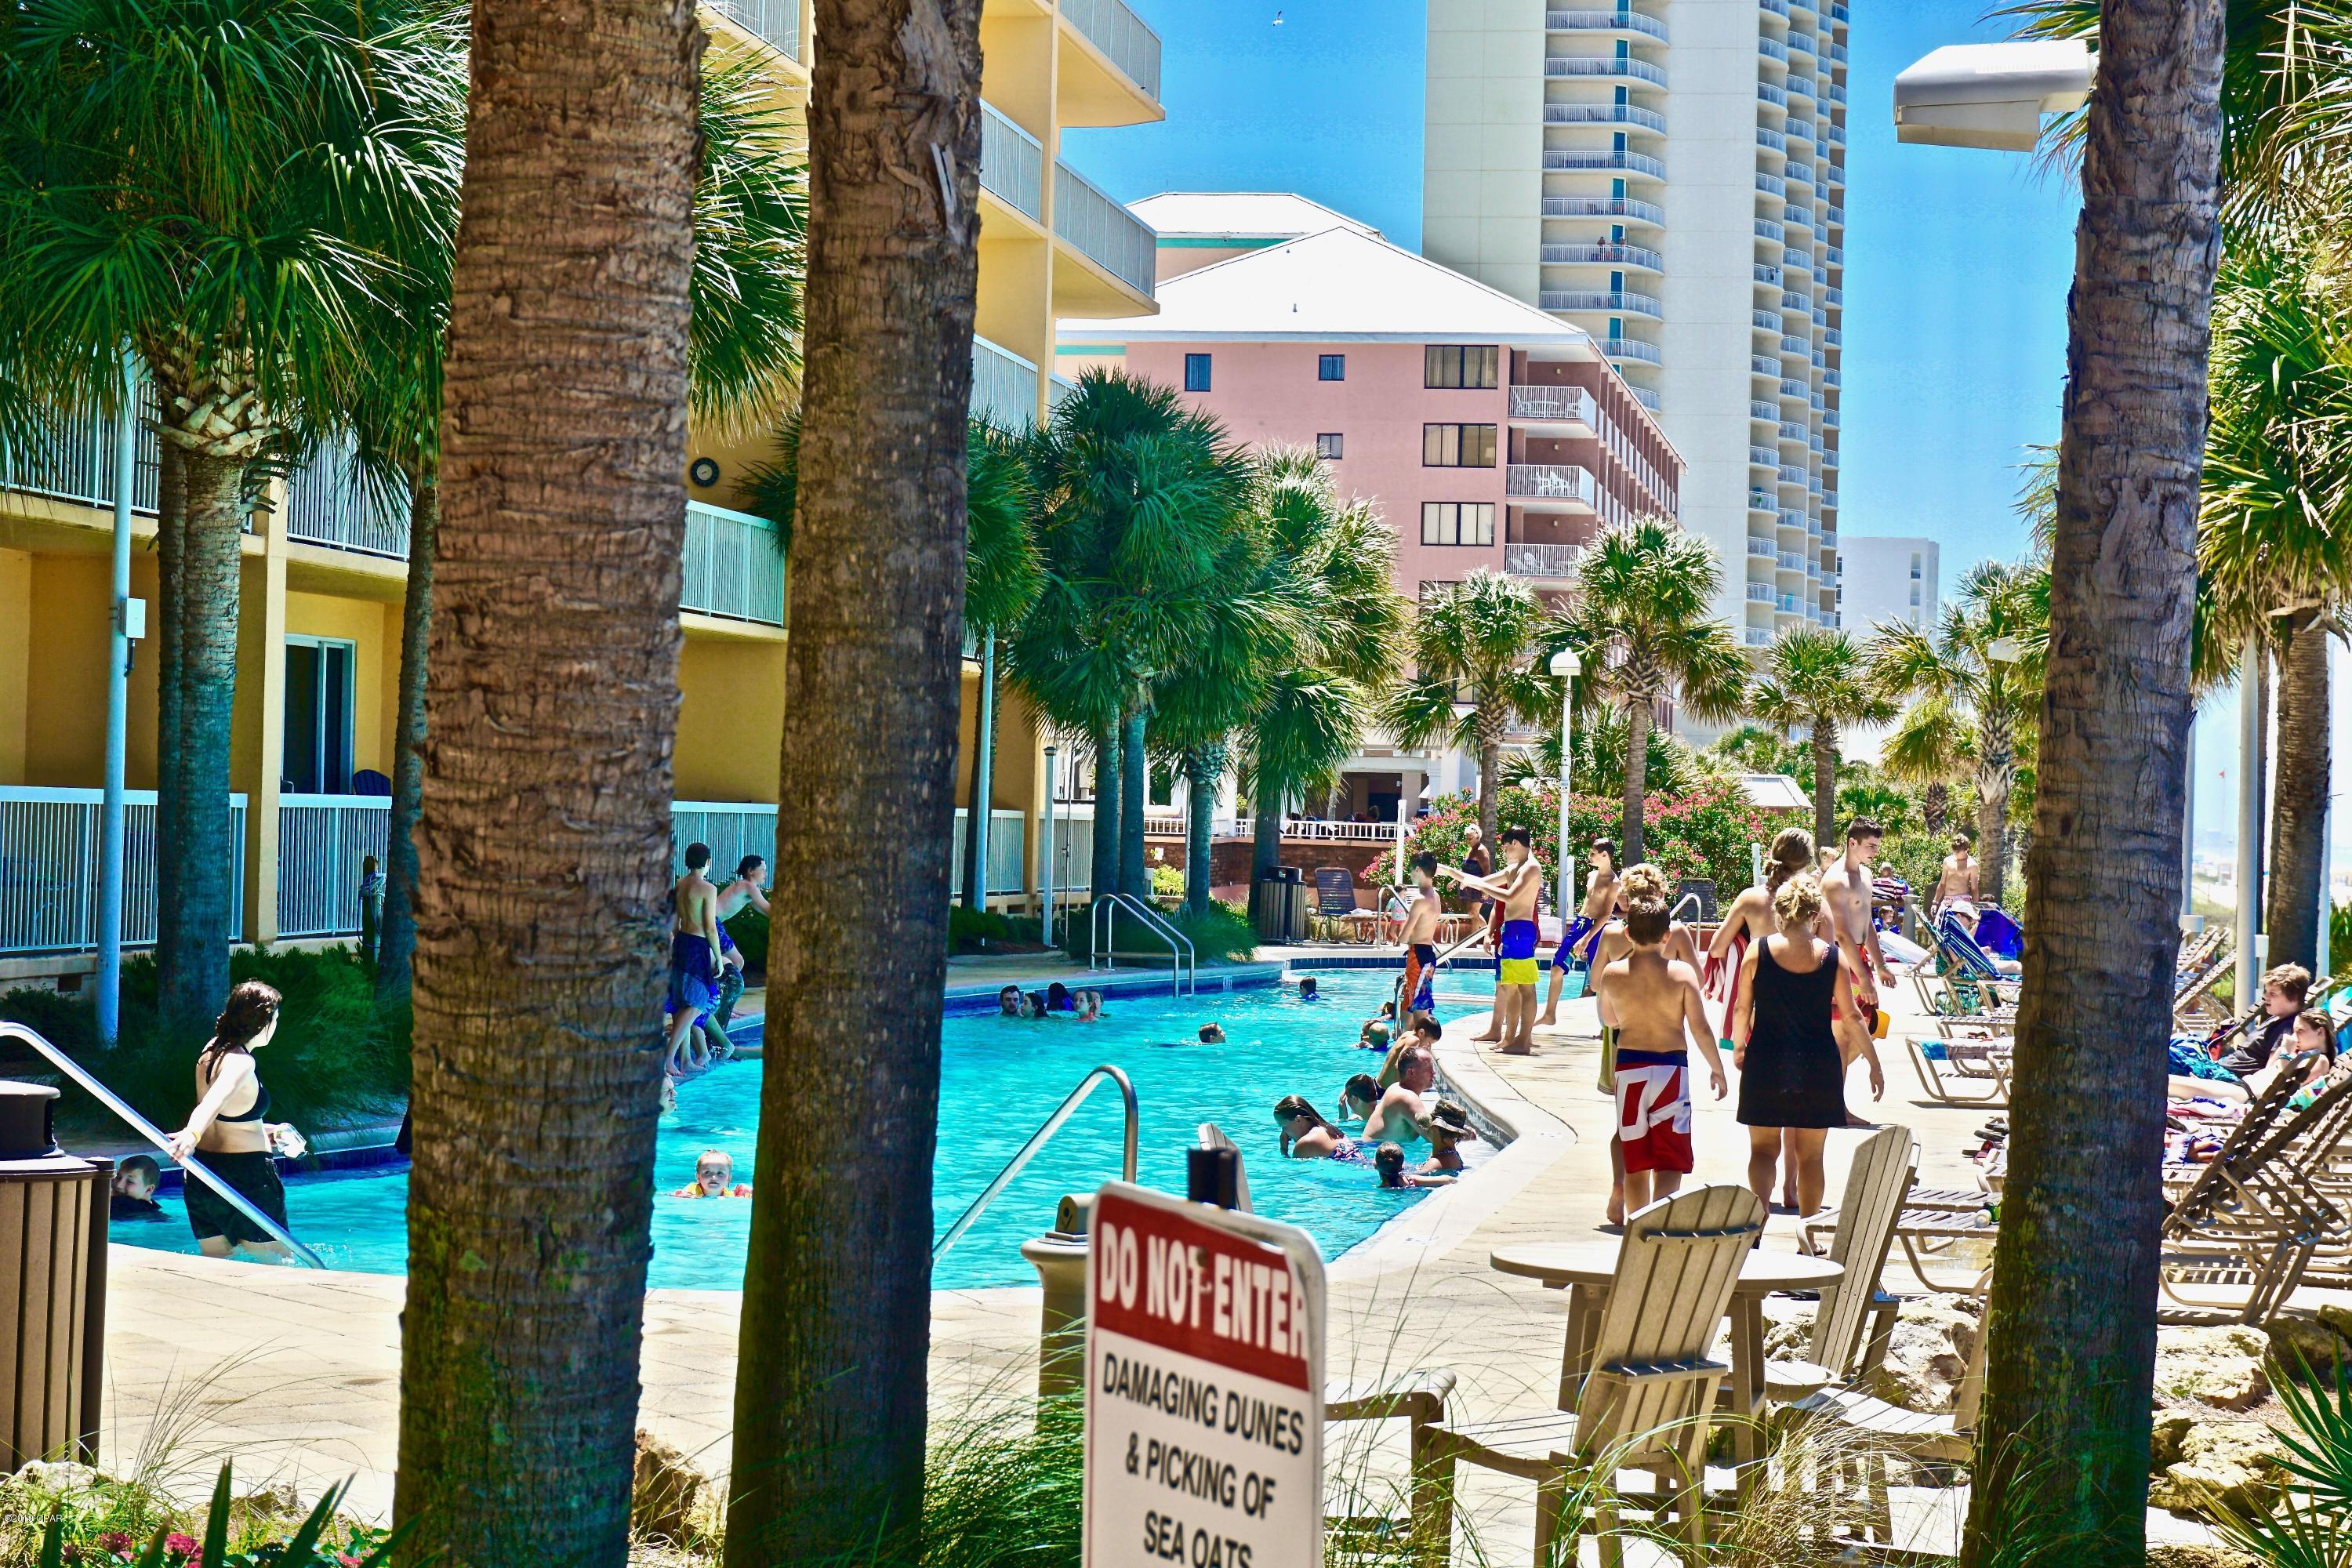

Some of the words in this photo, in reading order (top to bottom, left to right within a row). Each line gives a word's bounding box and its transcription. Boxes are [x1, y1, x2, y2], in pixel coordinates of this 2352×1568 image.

[1100, 1221, 1138, 1312] DO
[1146, 1234, 1207, 1330] NOT
[1213, 1251, 1309, 1361] ENTER
[1102, 1352, 1218, 1428] DAMAGING
[1224, 1391, 1305, 1457] DUNES
[1125, 1432, 1140, 1475] &
[1145, 1438, 1236, 1508] PICKING
[1243, 1472, 1276, 1520] OF
[1143, 1510, 1185, 1566] SEA
[1192, 1528, 1253, 1568] OATS
